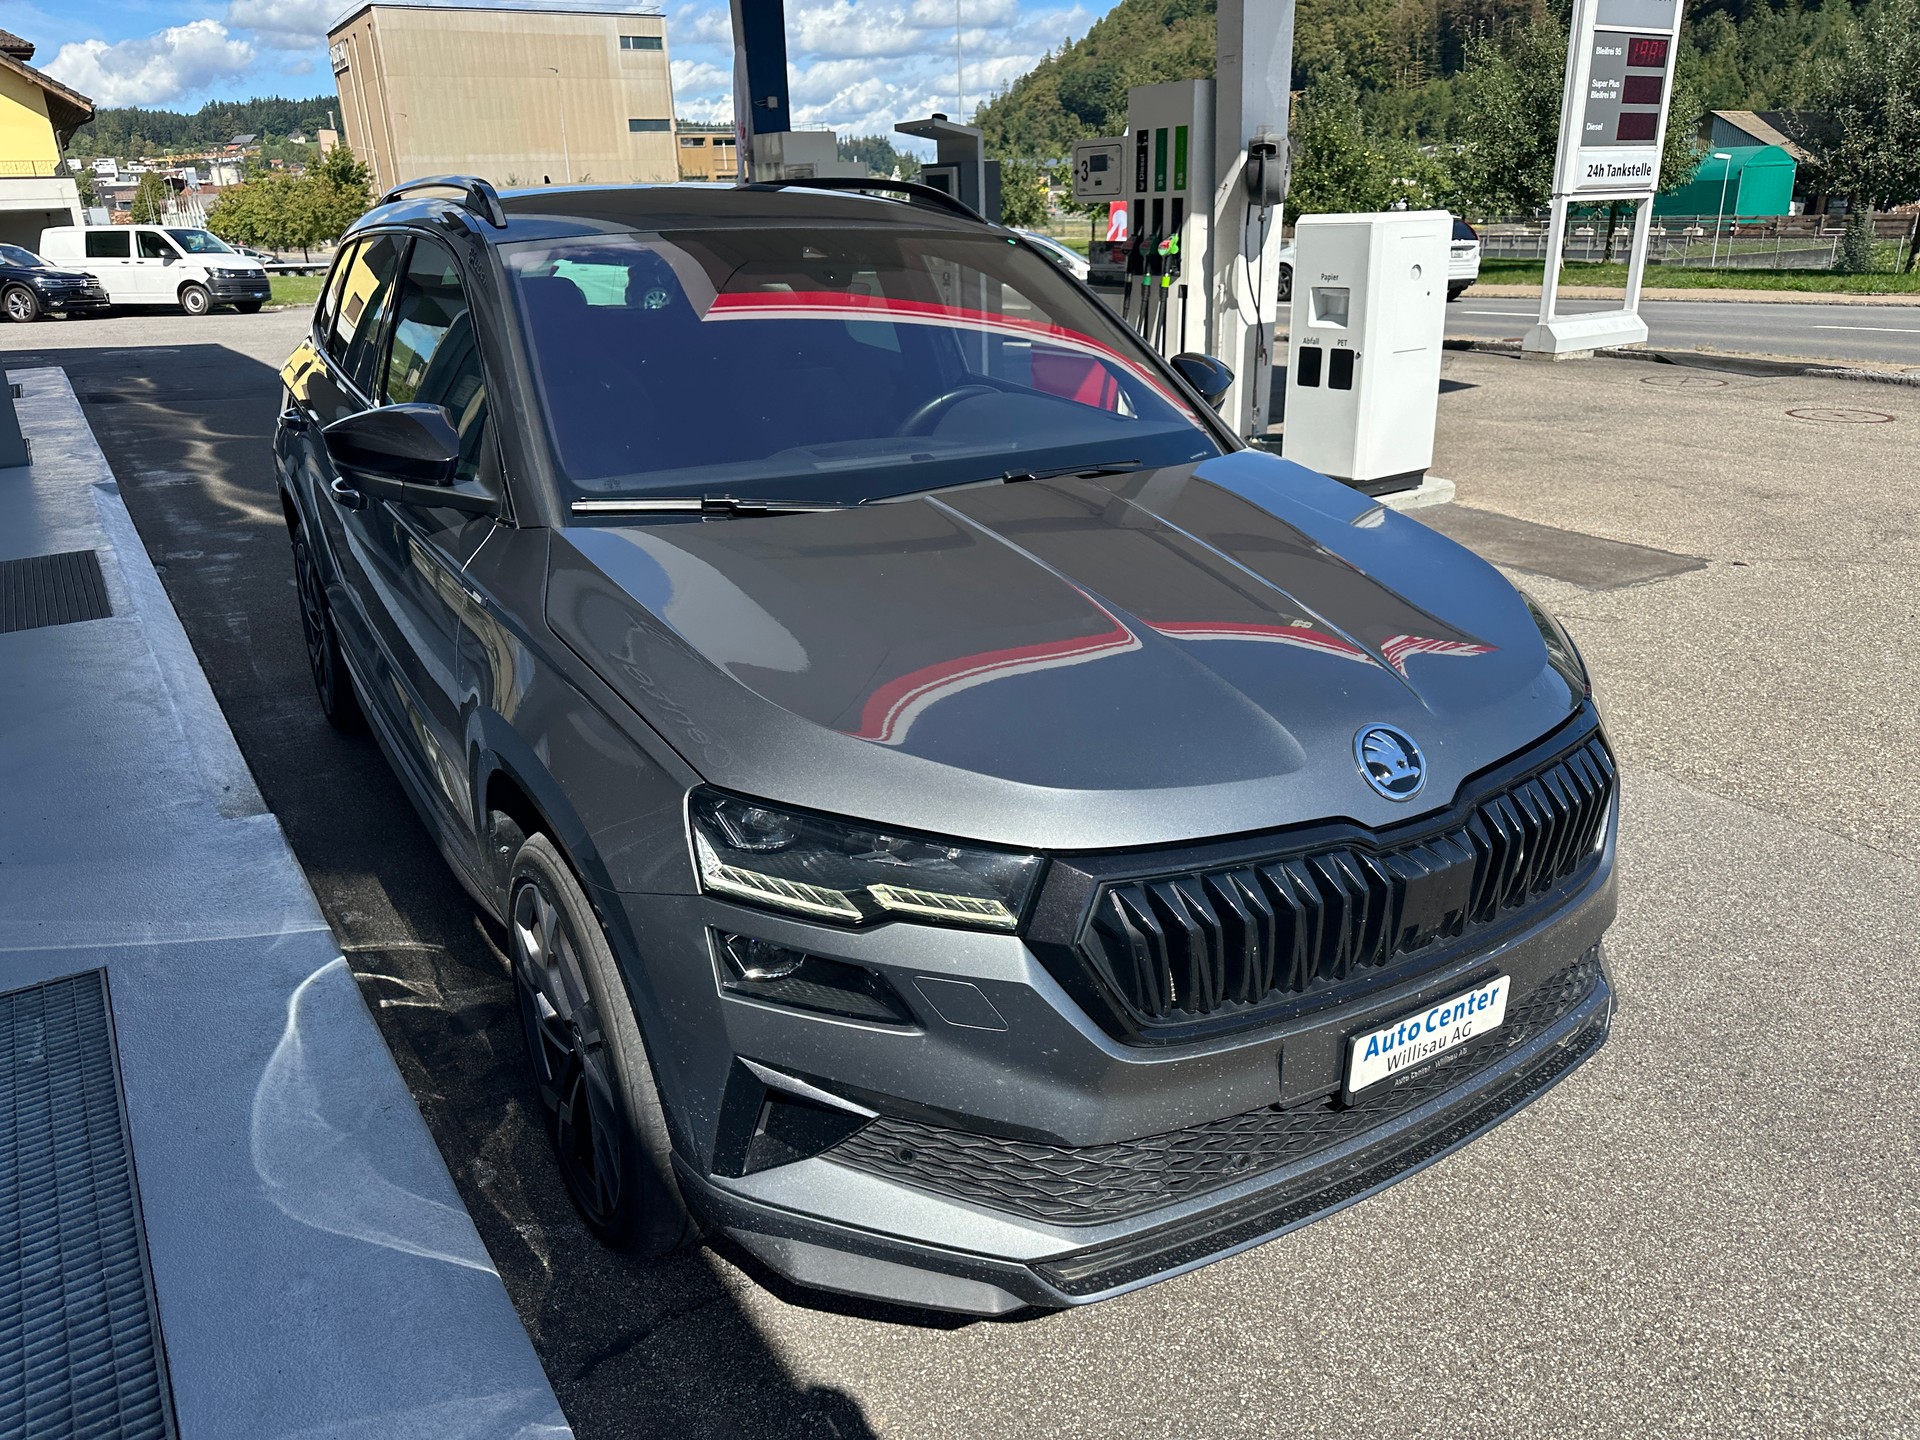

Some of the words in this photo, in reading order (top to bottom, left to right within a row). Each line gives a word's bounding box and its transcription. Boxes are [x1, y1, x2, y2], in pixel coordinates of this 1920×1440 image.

[1595, 46, 1614, 55] Bleifrei
[1615, 47, 1622, 56] 95
[1591, 79, 1608, 89] Super
[1608, 79, 1620, 88] Plus
[1590, 90, 1609, 99] Bleifrei
[1586, 122, 1604, 131] Diesel
[1081, 160, 1089, 182] 3
[1587, 163, 1604, 178] 24h
[1607, 162, 1652, 177] Tankstelle
[1320, 273, 1339, 282] Papier
[1302, 337, 1320, 345] Abfall
[1337, 339, 1348, 347] PET
[1363, 1021, 1421, 1062] Auto
[1425, 987, 1500, 1033] Center
[1387, 1035, 1447, 1072] Willisau
[1451, 1021, 1473, 1044] AG
